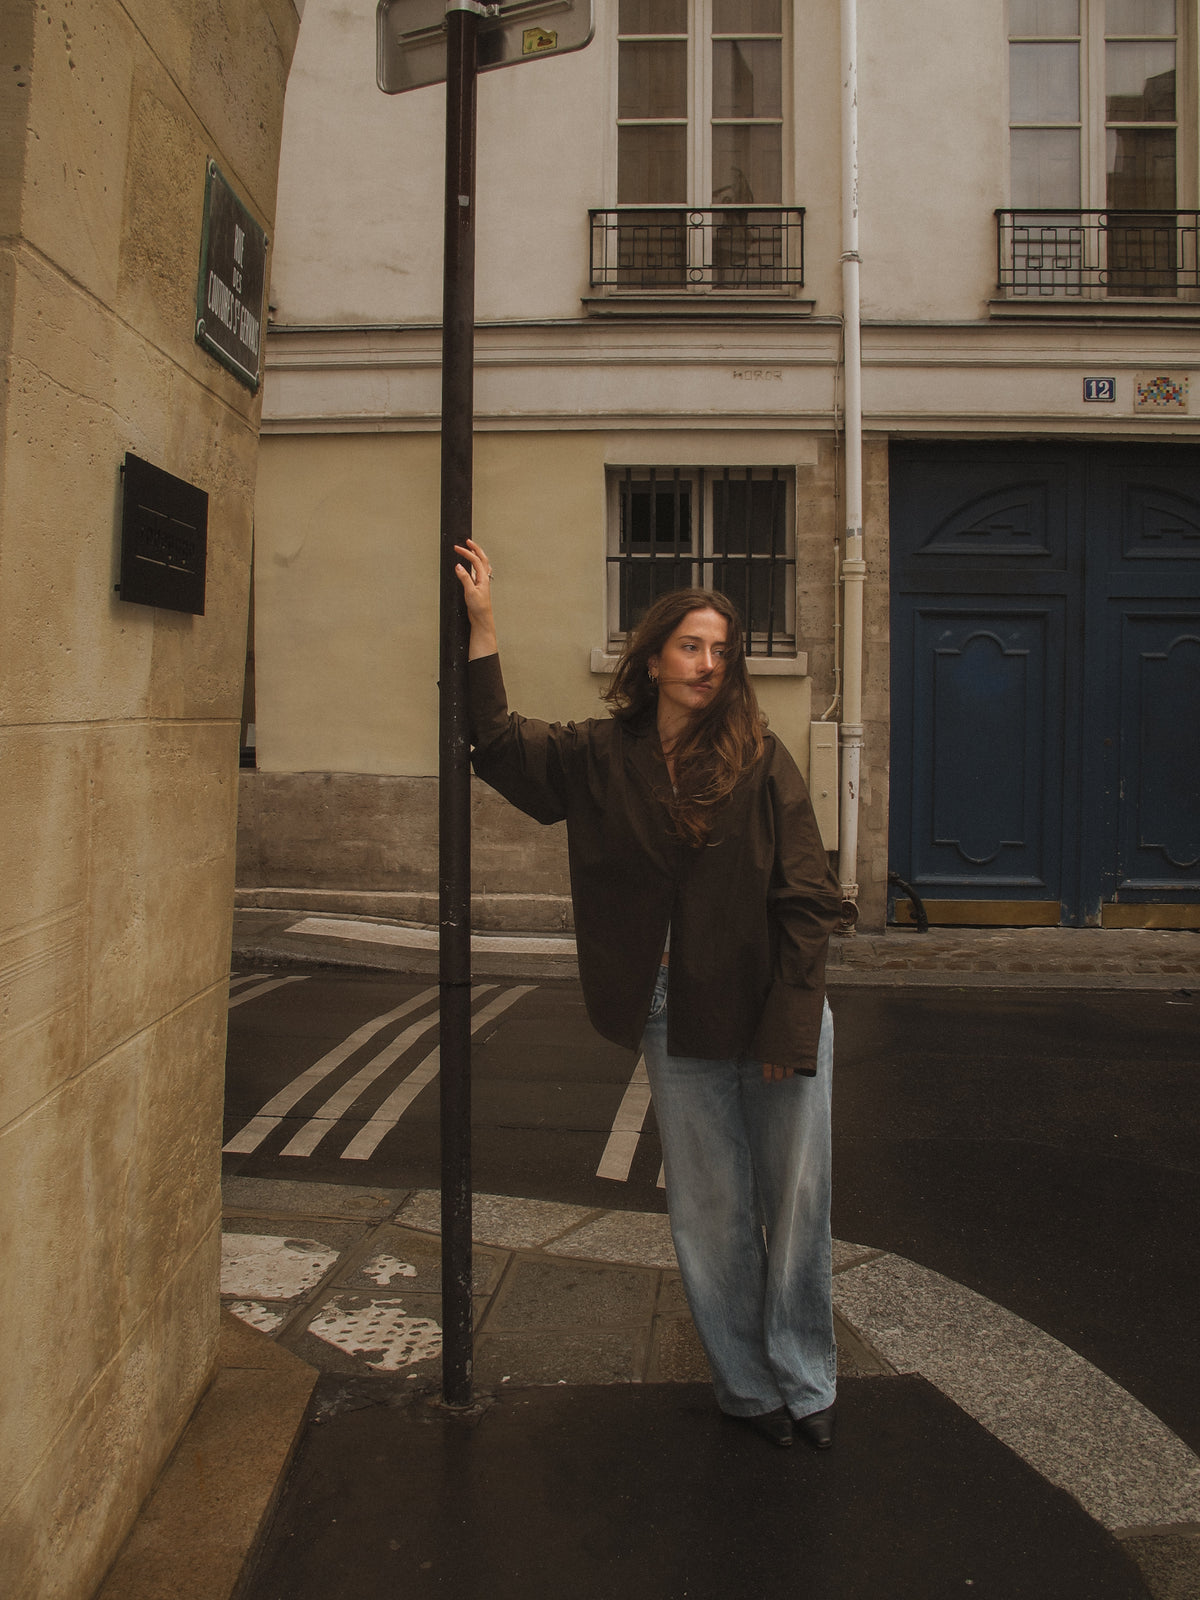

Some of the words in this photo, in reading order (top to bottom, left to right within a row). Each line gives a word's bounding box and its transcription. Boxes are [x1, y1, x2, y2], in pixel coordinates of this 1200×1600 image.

[233, 224, 245, 269] RUE
[232, 267, 243, 294] DES
[1089, 380, 1110, 399] 12
